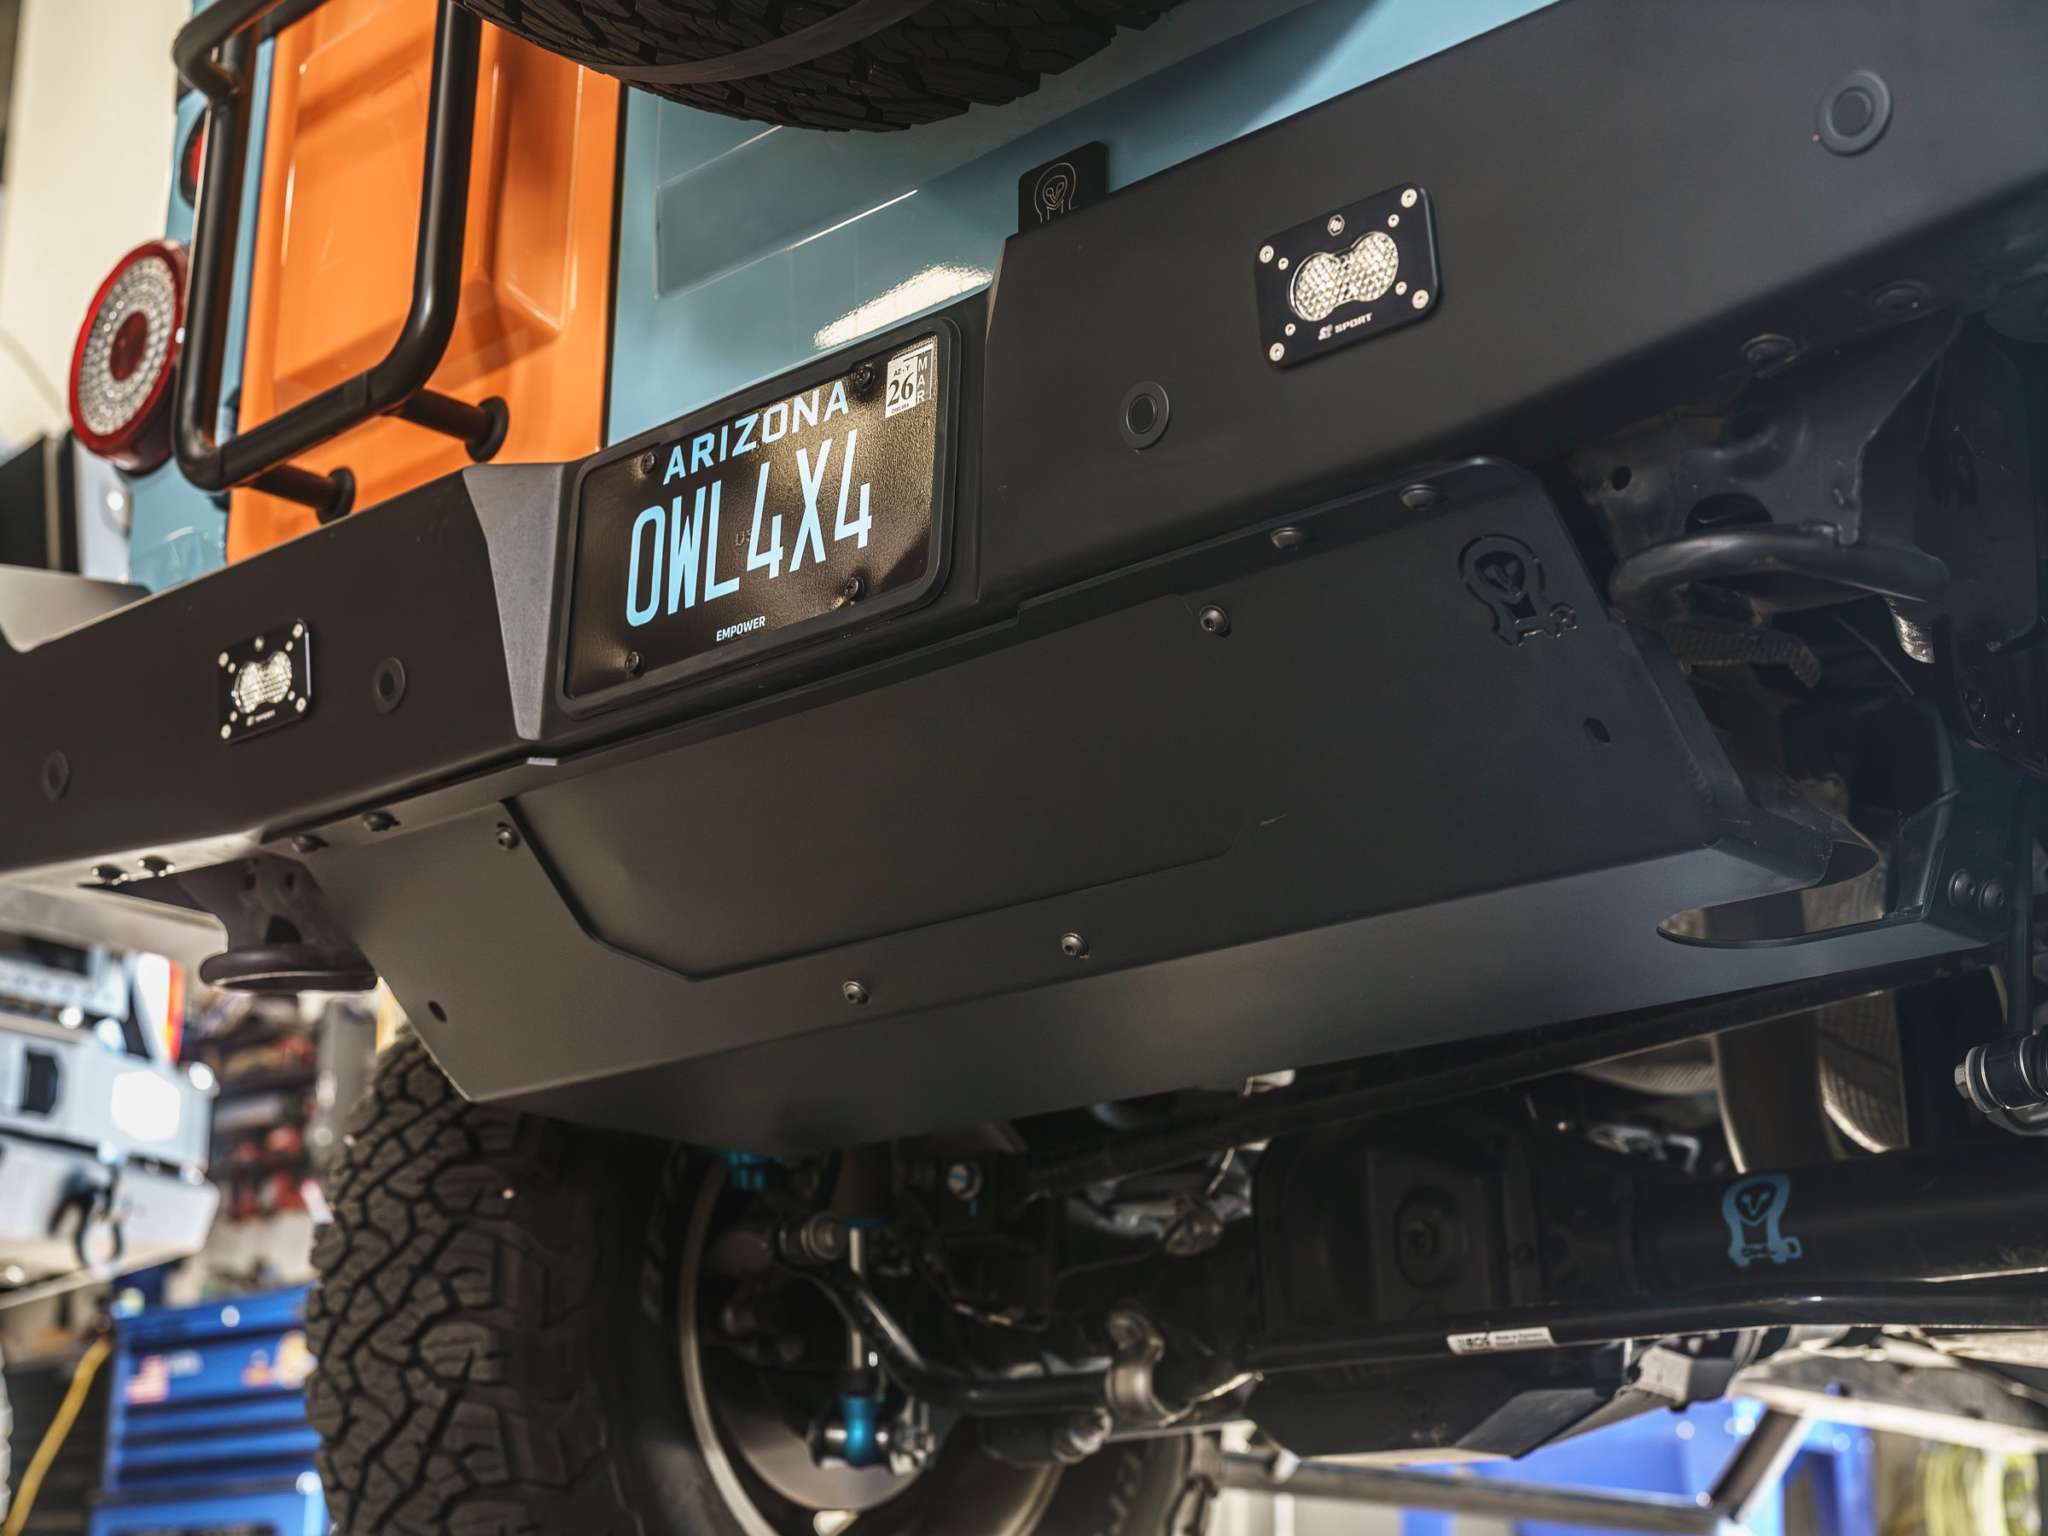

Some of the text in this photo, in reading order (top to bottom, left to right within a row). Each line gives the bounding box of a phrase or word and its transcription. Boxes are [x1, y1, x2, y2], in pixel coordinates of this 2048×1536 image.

[1334, 312, 1373, 333] SPORT
[888, 372, 913, 406] 26
[917, 357, 928, 404] MAR
[663, 381, 849, 485] ARIZONA
[716, 616, 766, 641] EMPOWER
